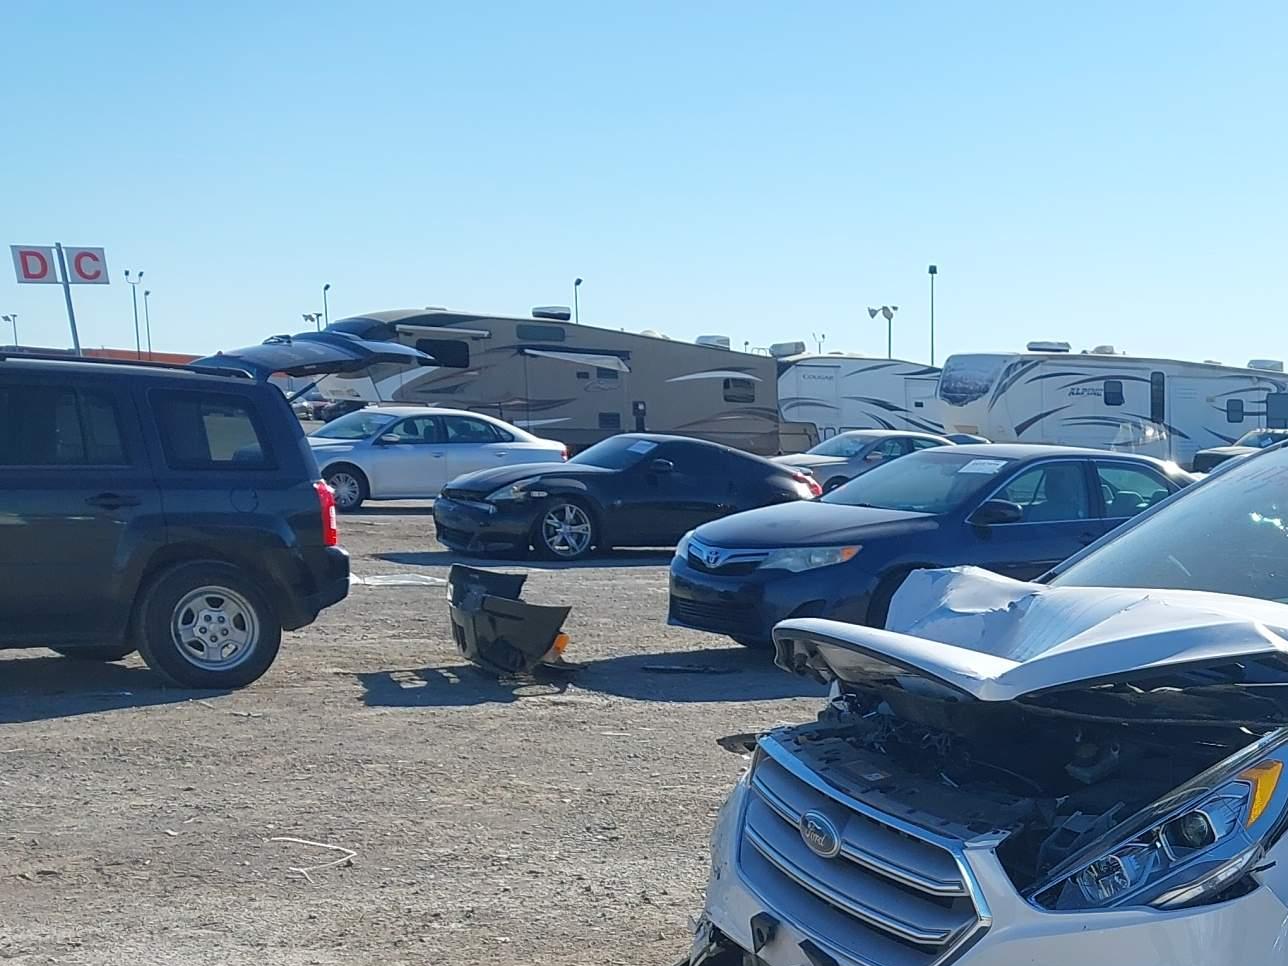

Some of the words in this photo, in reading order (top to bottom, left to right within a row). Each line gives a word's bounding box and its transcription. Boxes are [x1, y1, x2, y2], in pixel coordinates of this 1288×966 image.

[19, 250, 48, 280] D
[74, 251, 102, 281] C
[805, 820, 826, 847] Ford
